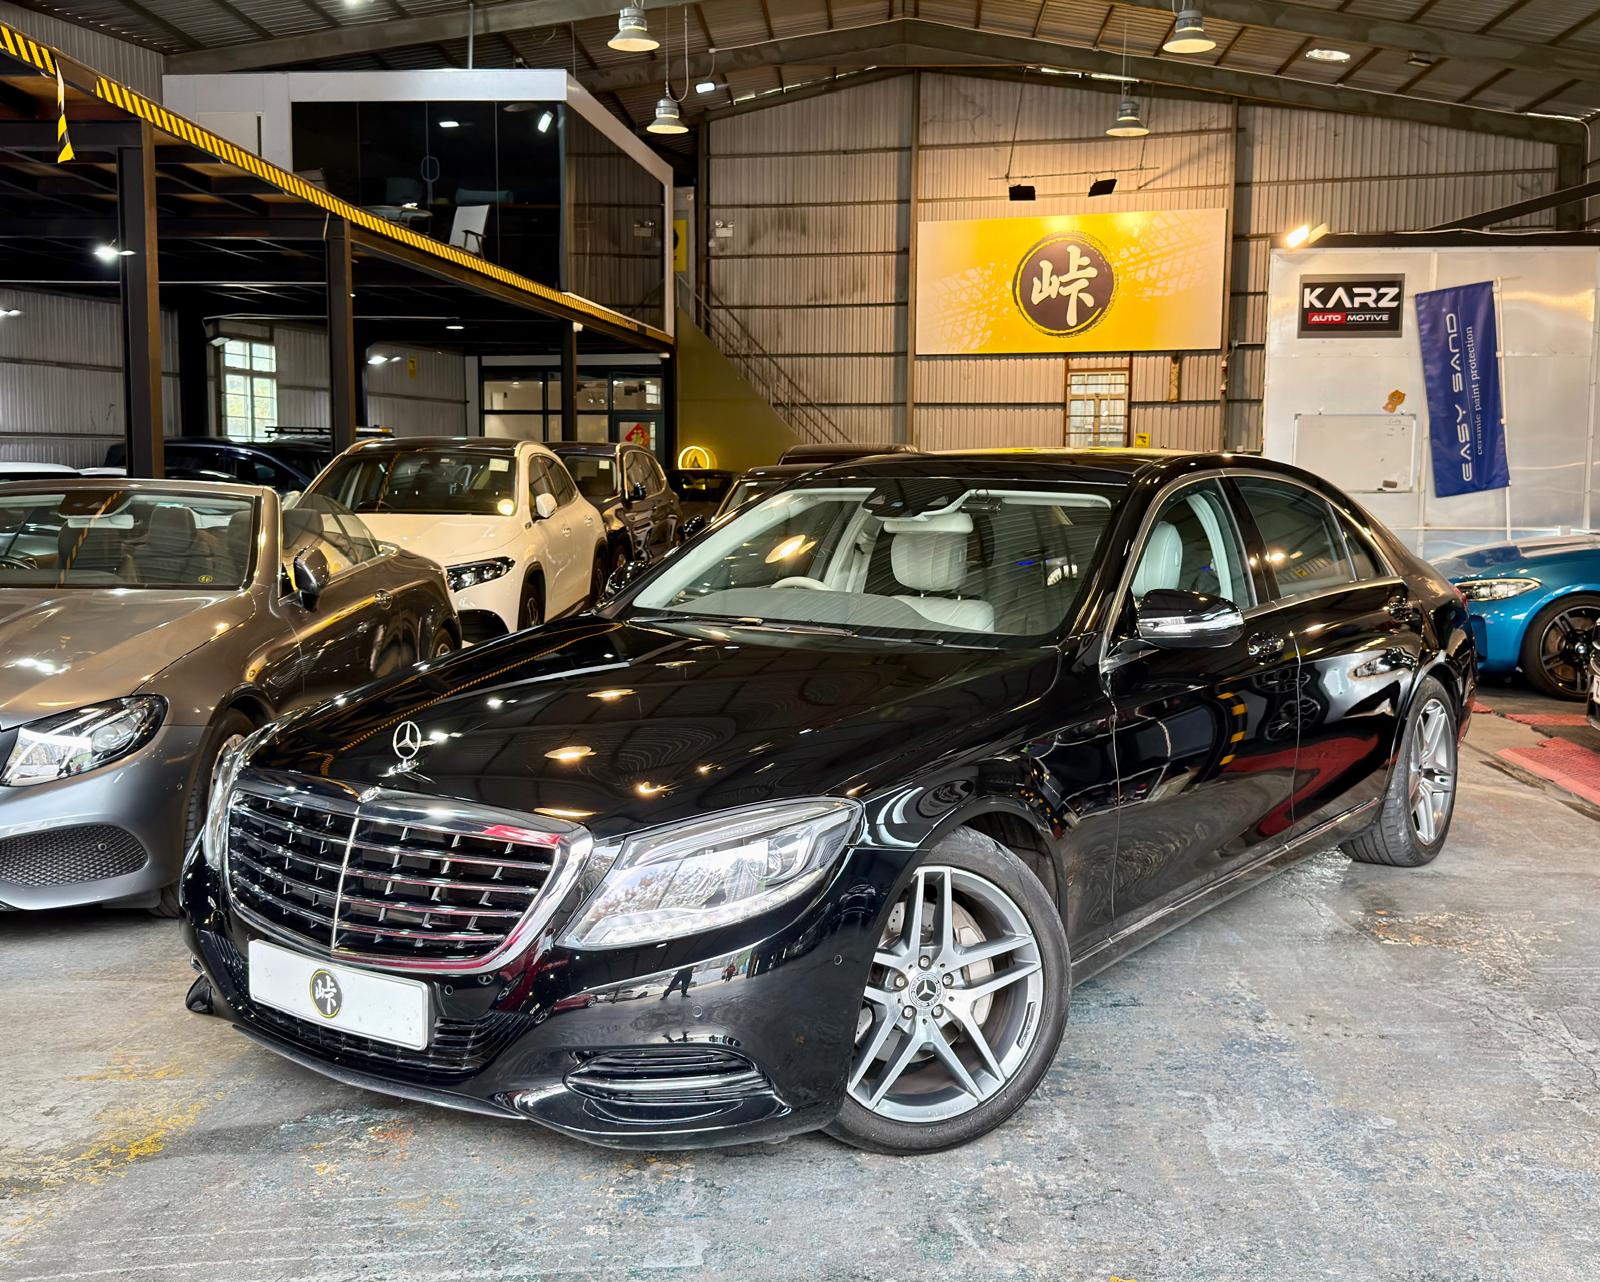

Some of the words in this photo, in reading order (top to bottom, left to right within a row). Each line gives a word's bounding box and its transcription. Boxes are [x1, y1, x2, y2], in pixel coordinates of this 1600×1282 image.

[1031, 244, 1097, 326] 峠
[1303, 286, 1400, 308] KARZ
[1311, 314, 1342, 322] AUTO
[1446, 313, 1463, 393] SAND
[1465, 326, 1481, 380] protection
[1471, 383, 1482, 411] paint
[1454, 404, 1472, 481] EASY
[1474, 413, 1483, 455] ceramic
